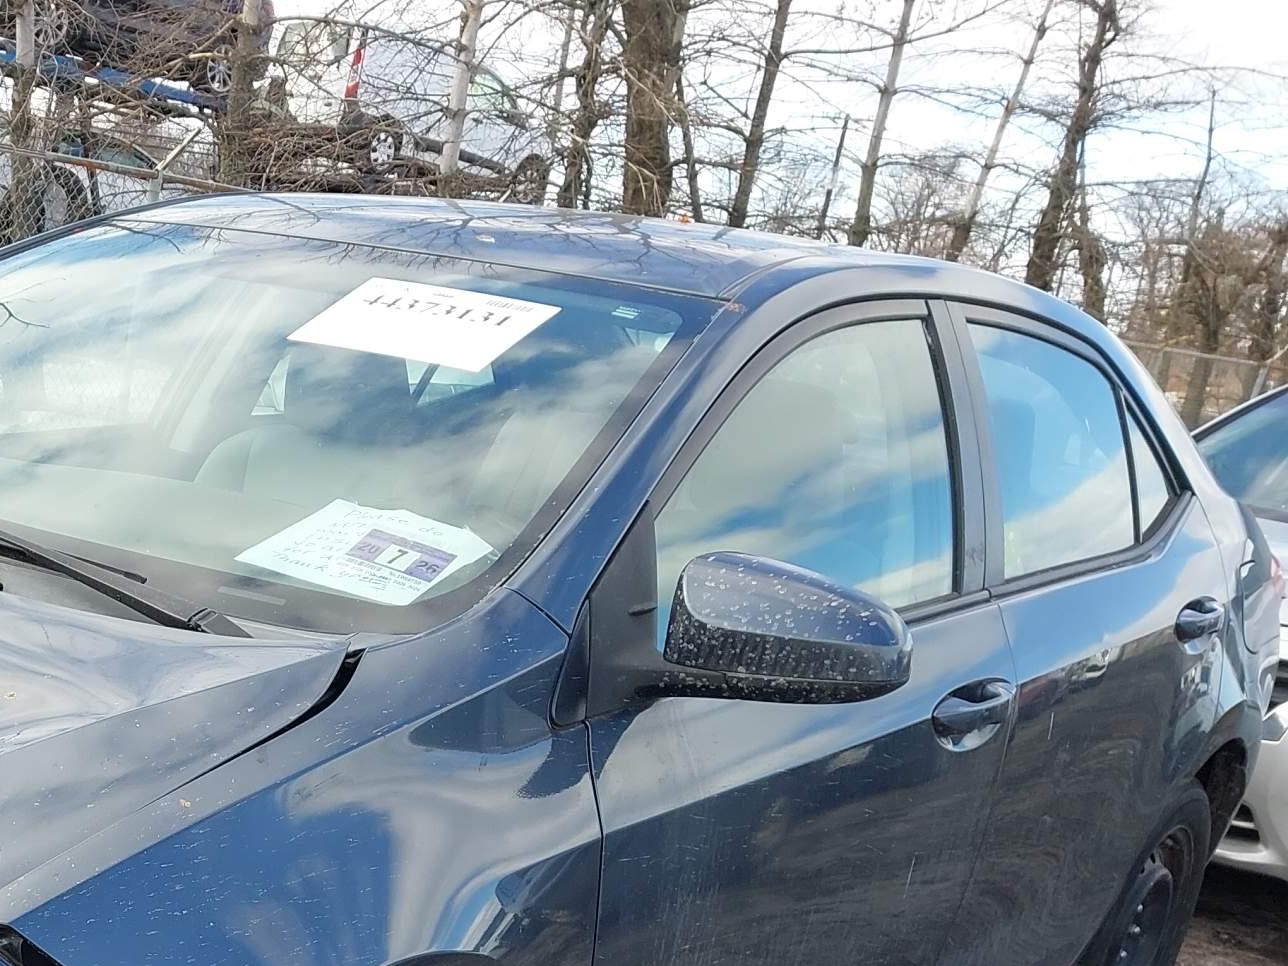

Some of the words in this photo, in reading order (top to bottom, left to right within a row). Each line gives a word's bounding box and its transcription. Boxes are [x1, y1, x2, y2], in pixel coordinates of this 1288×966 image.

[362, 295, 512, 327] 44373131
[357, 542, 381, 554] 20
[387, 548, 409, 564] 7
[416, 560, 440, 574] 26
